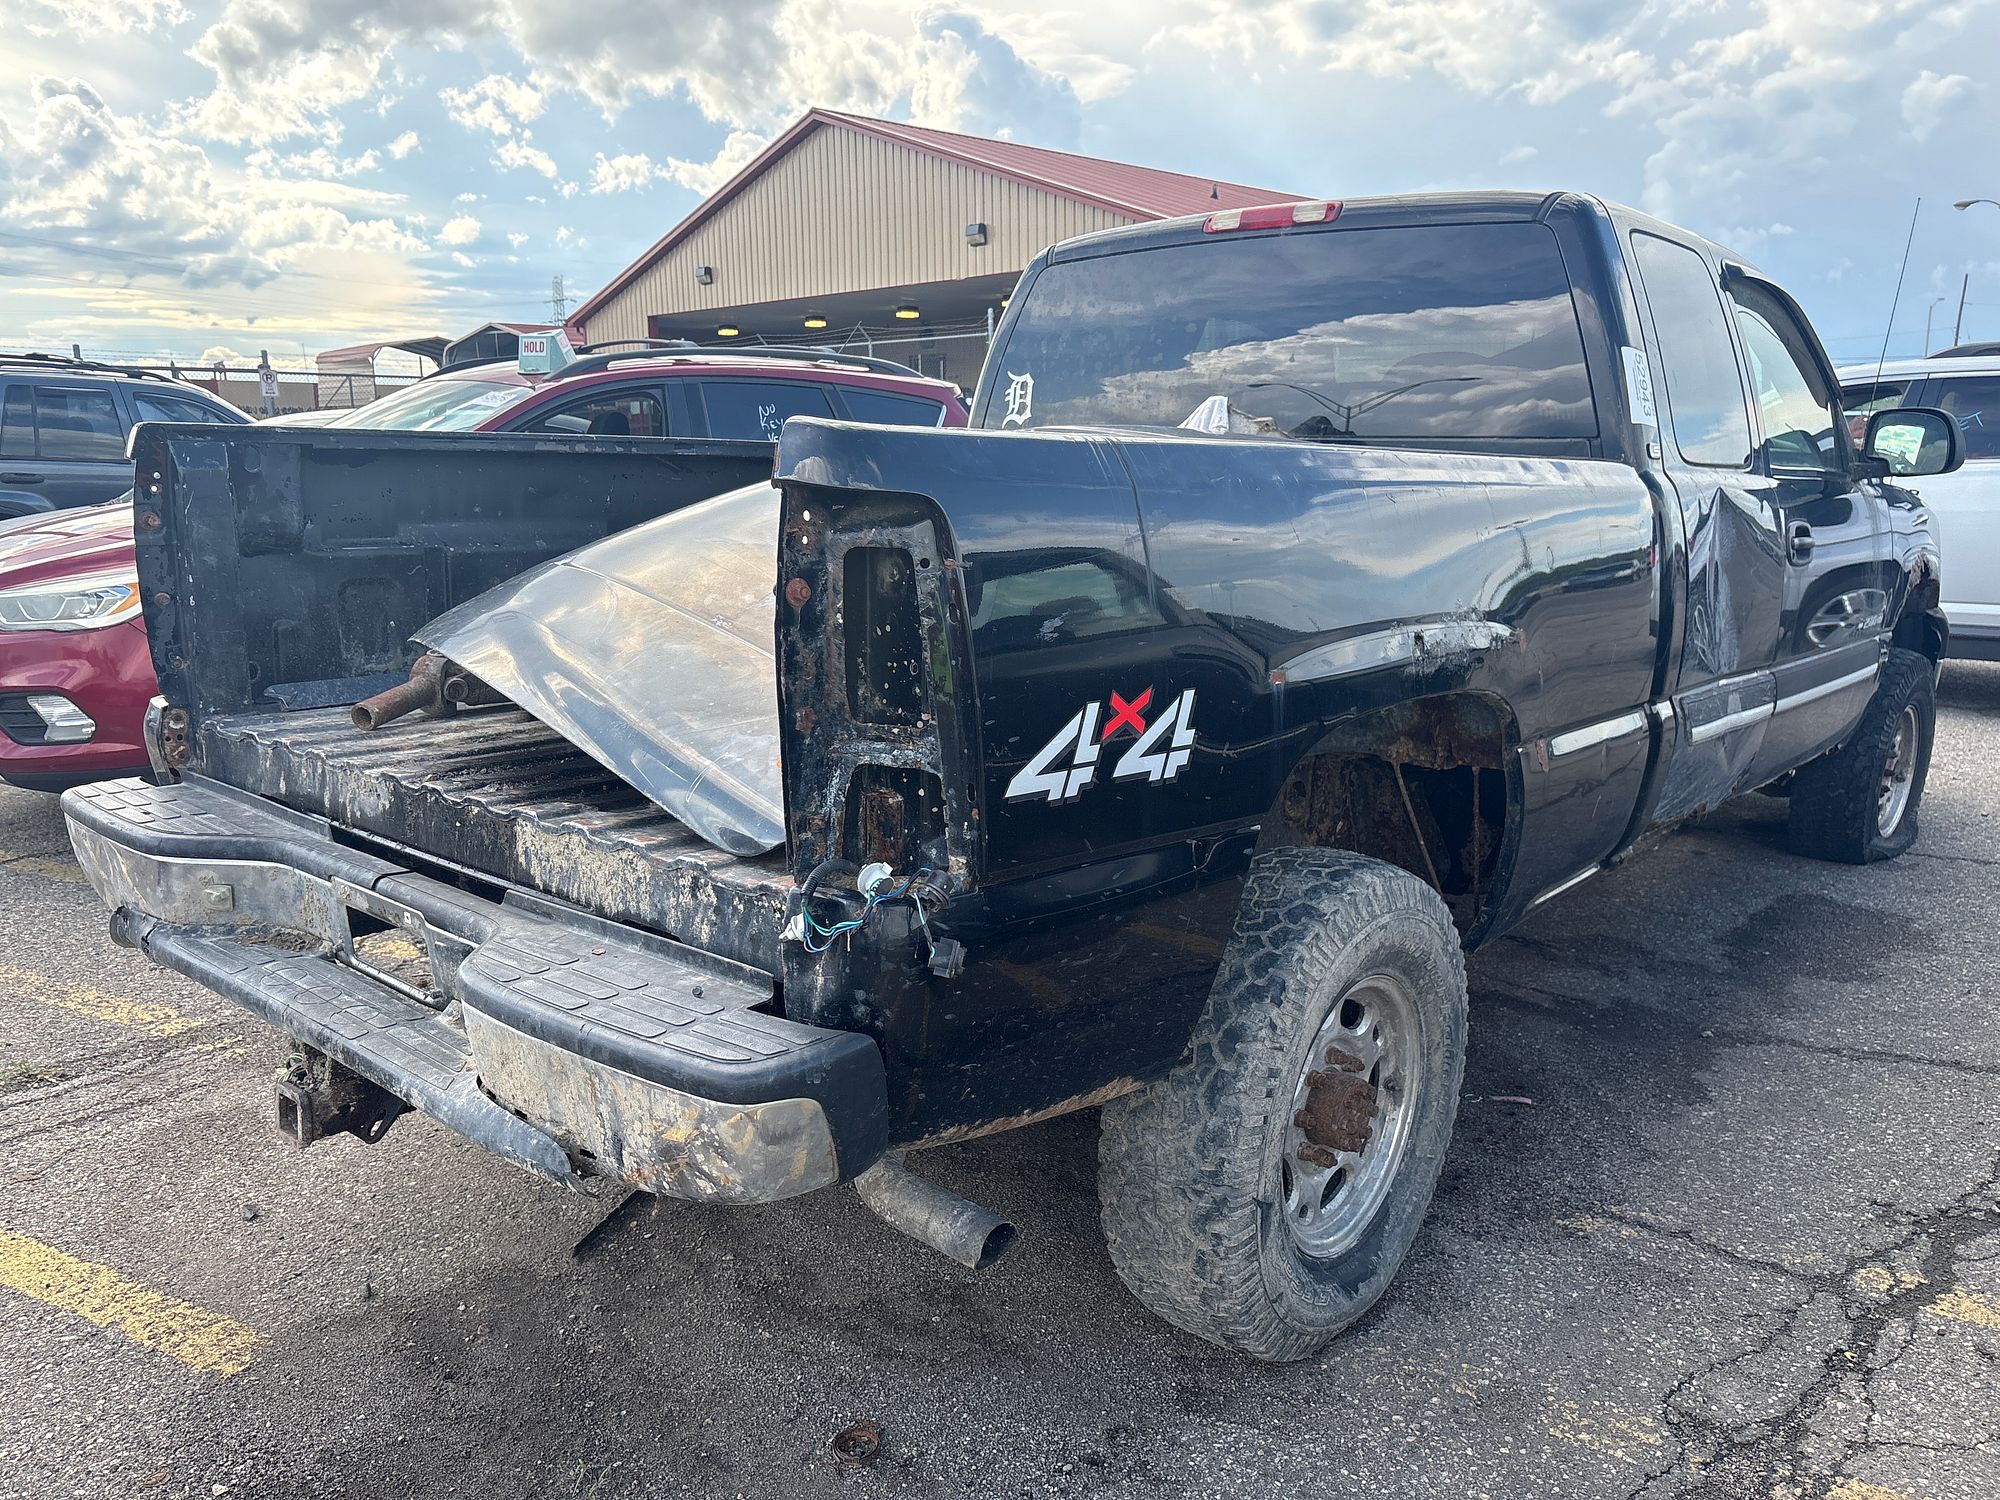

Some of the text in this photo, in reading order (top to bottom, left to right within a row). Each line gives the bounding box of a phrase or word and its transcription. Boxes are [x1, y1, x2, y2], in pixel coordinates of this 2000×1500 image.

[523, 341, 545, 353] HOLD
[1634, 352, 1652, 417] 52943
[758, 403, 776, 418] NO
